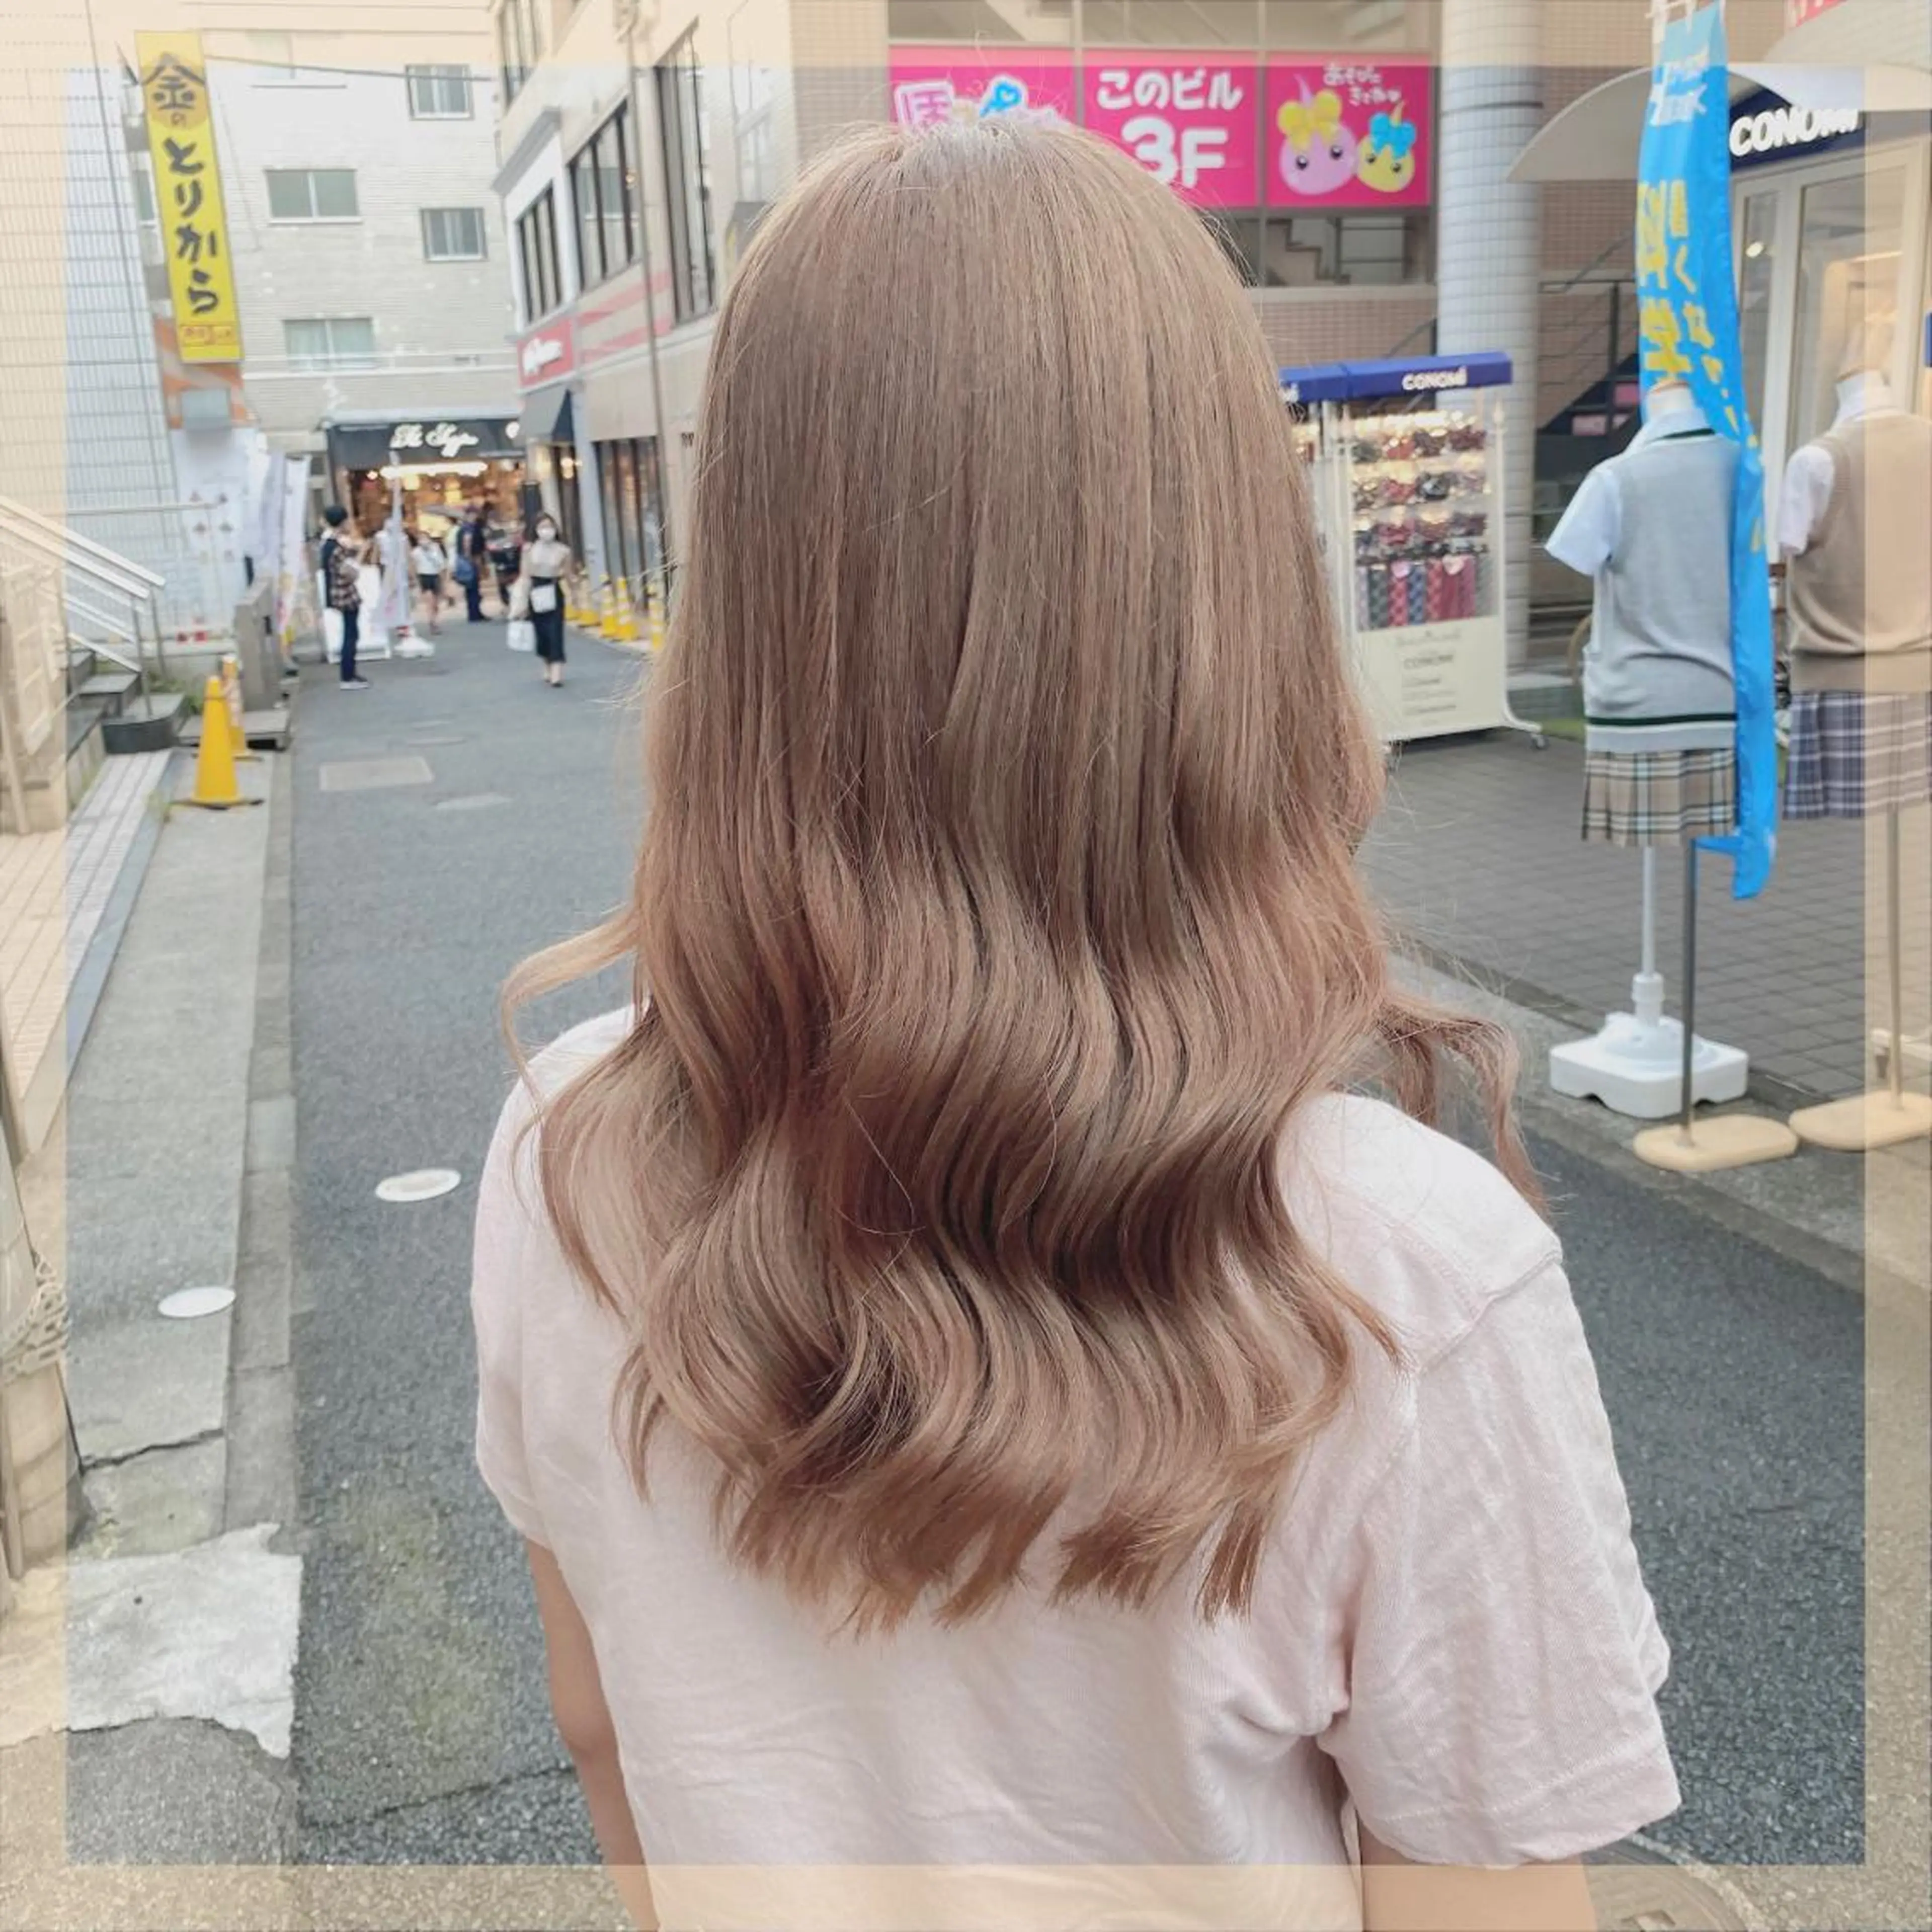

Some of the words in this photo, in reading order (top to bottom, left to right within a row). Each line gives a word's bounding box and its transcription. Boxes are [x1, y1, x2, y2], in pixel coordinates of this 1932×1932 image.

[1097, 67, 1244, 110] このビル
[1121, 116, 1228, 188] 3F
